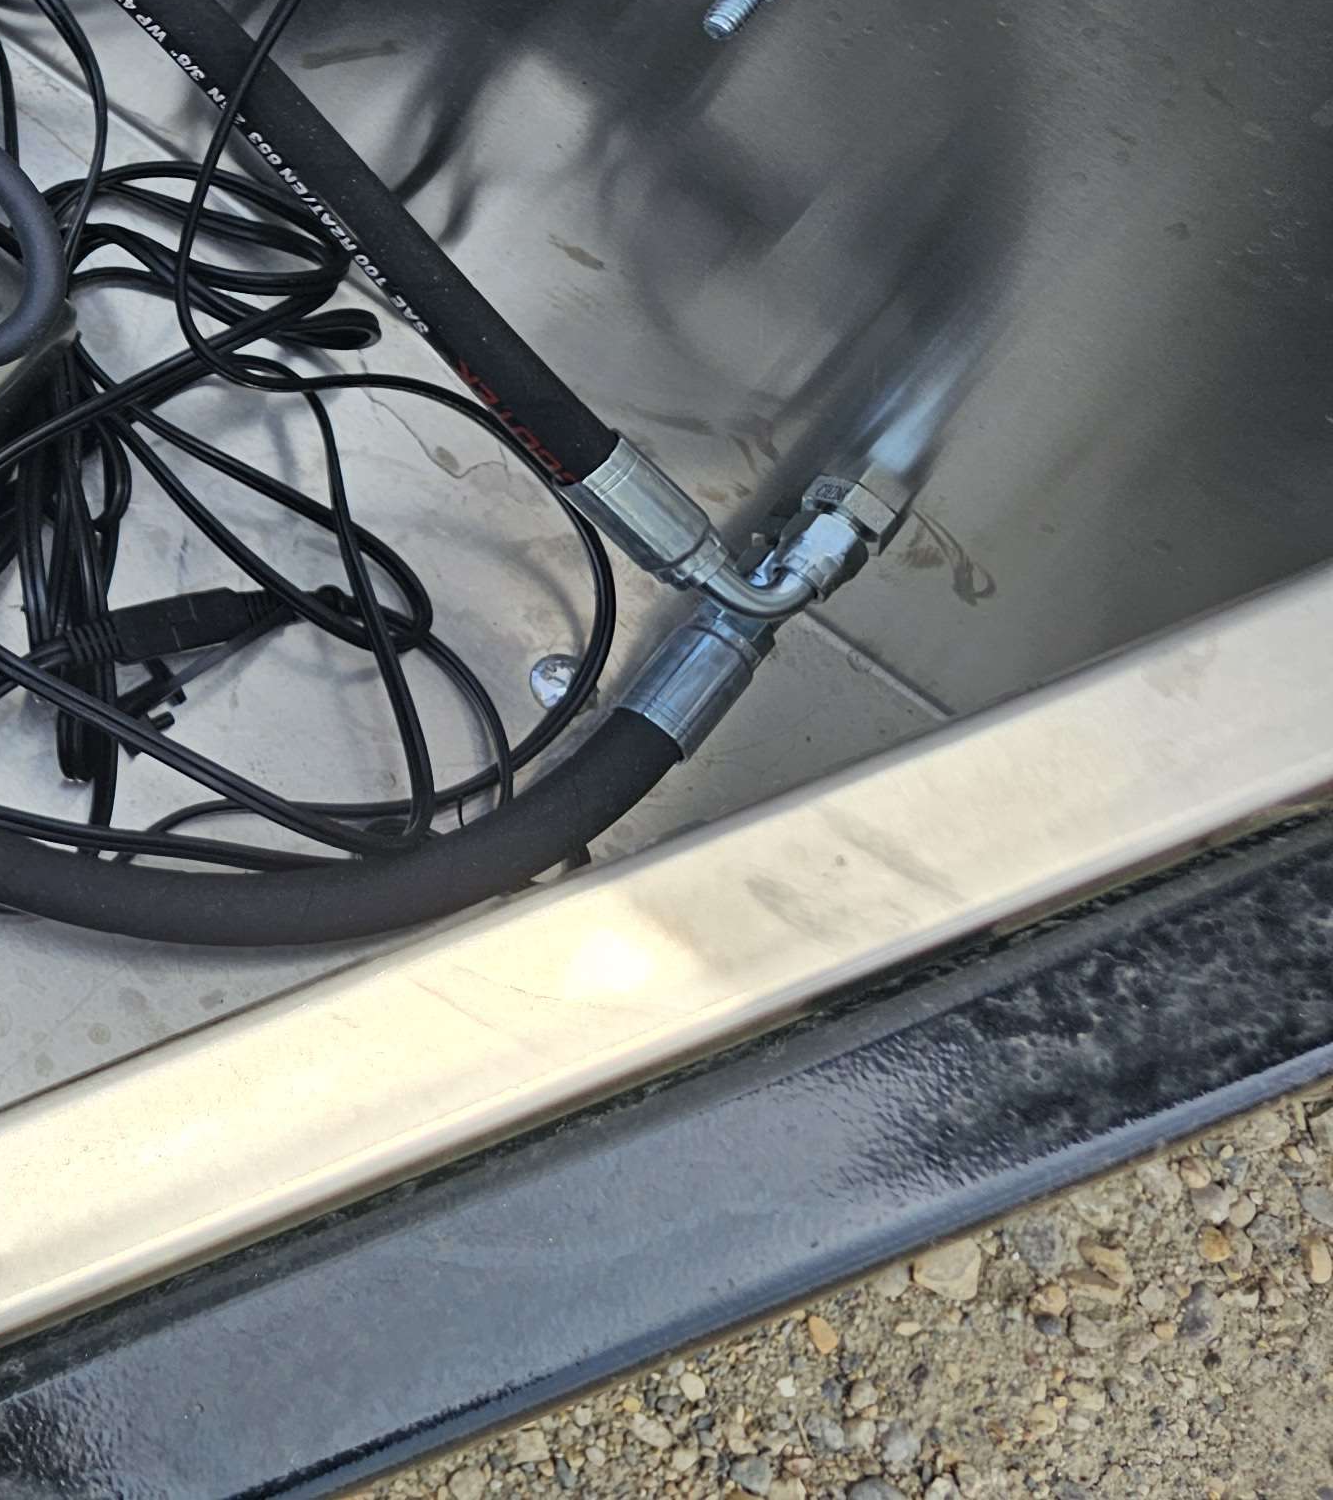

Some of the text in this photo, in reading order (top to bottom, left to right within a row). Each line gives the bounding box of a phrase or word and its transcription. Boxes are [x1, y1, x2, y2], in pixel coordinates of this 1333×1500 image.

[206, 84, 247, 128] 2N
[277, 165, 358, 255] R2AT/EN
[352, 250, 388, 289] 100
[389, 292, 430, 337] SAE
